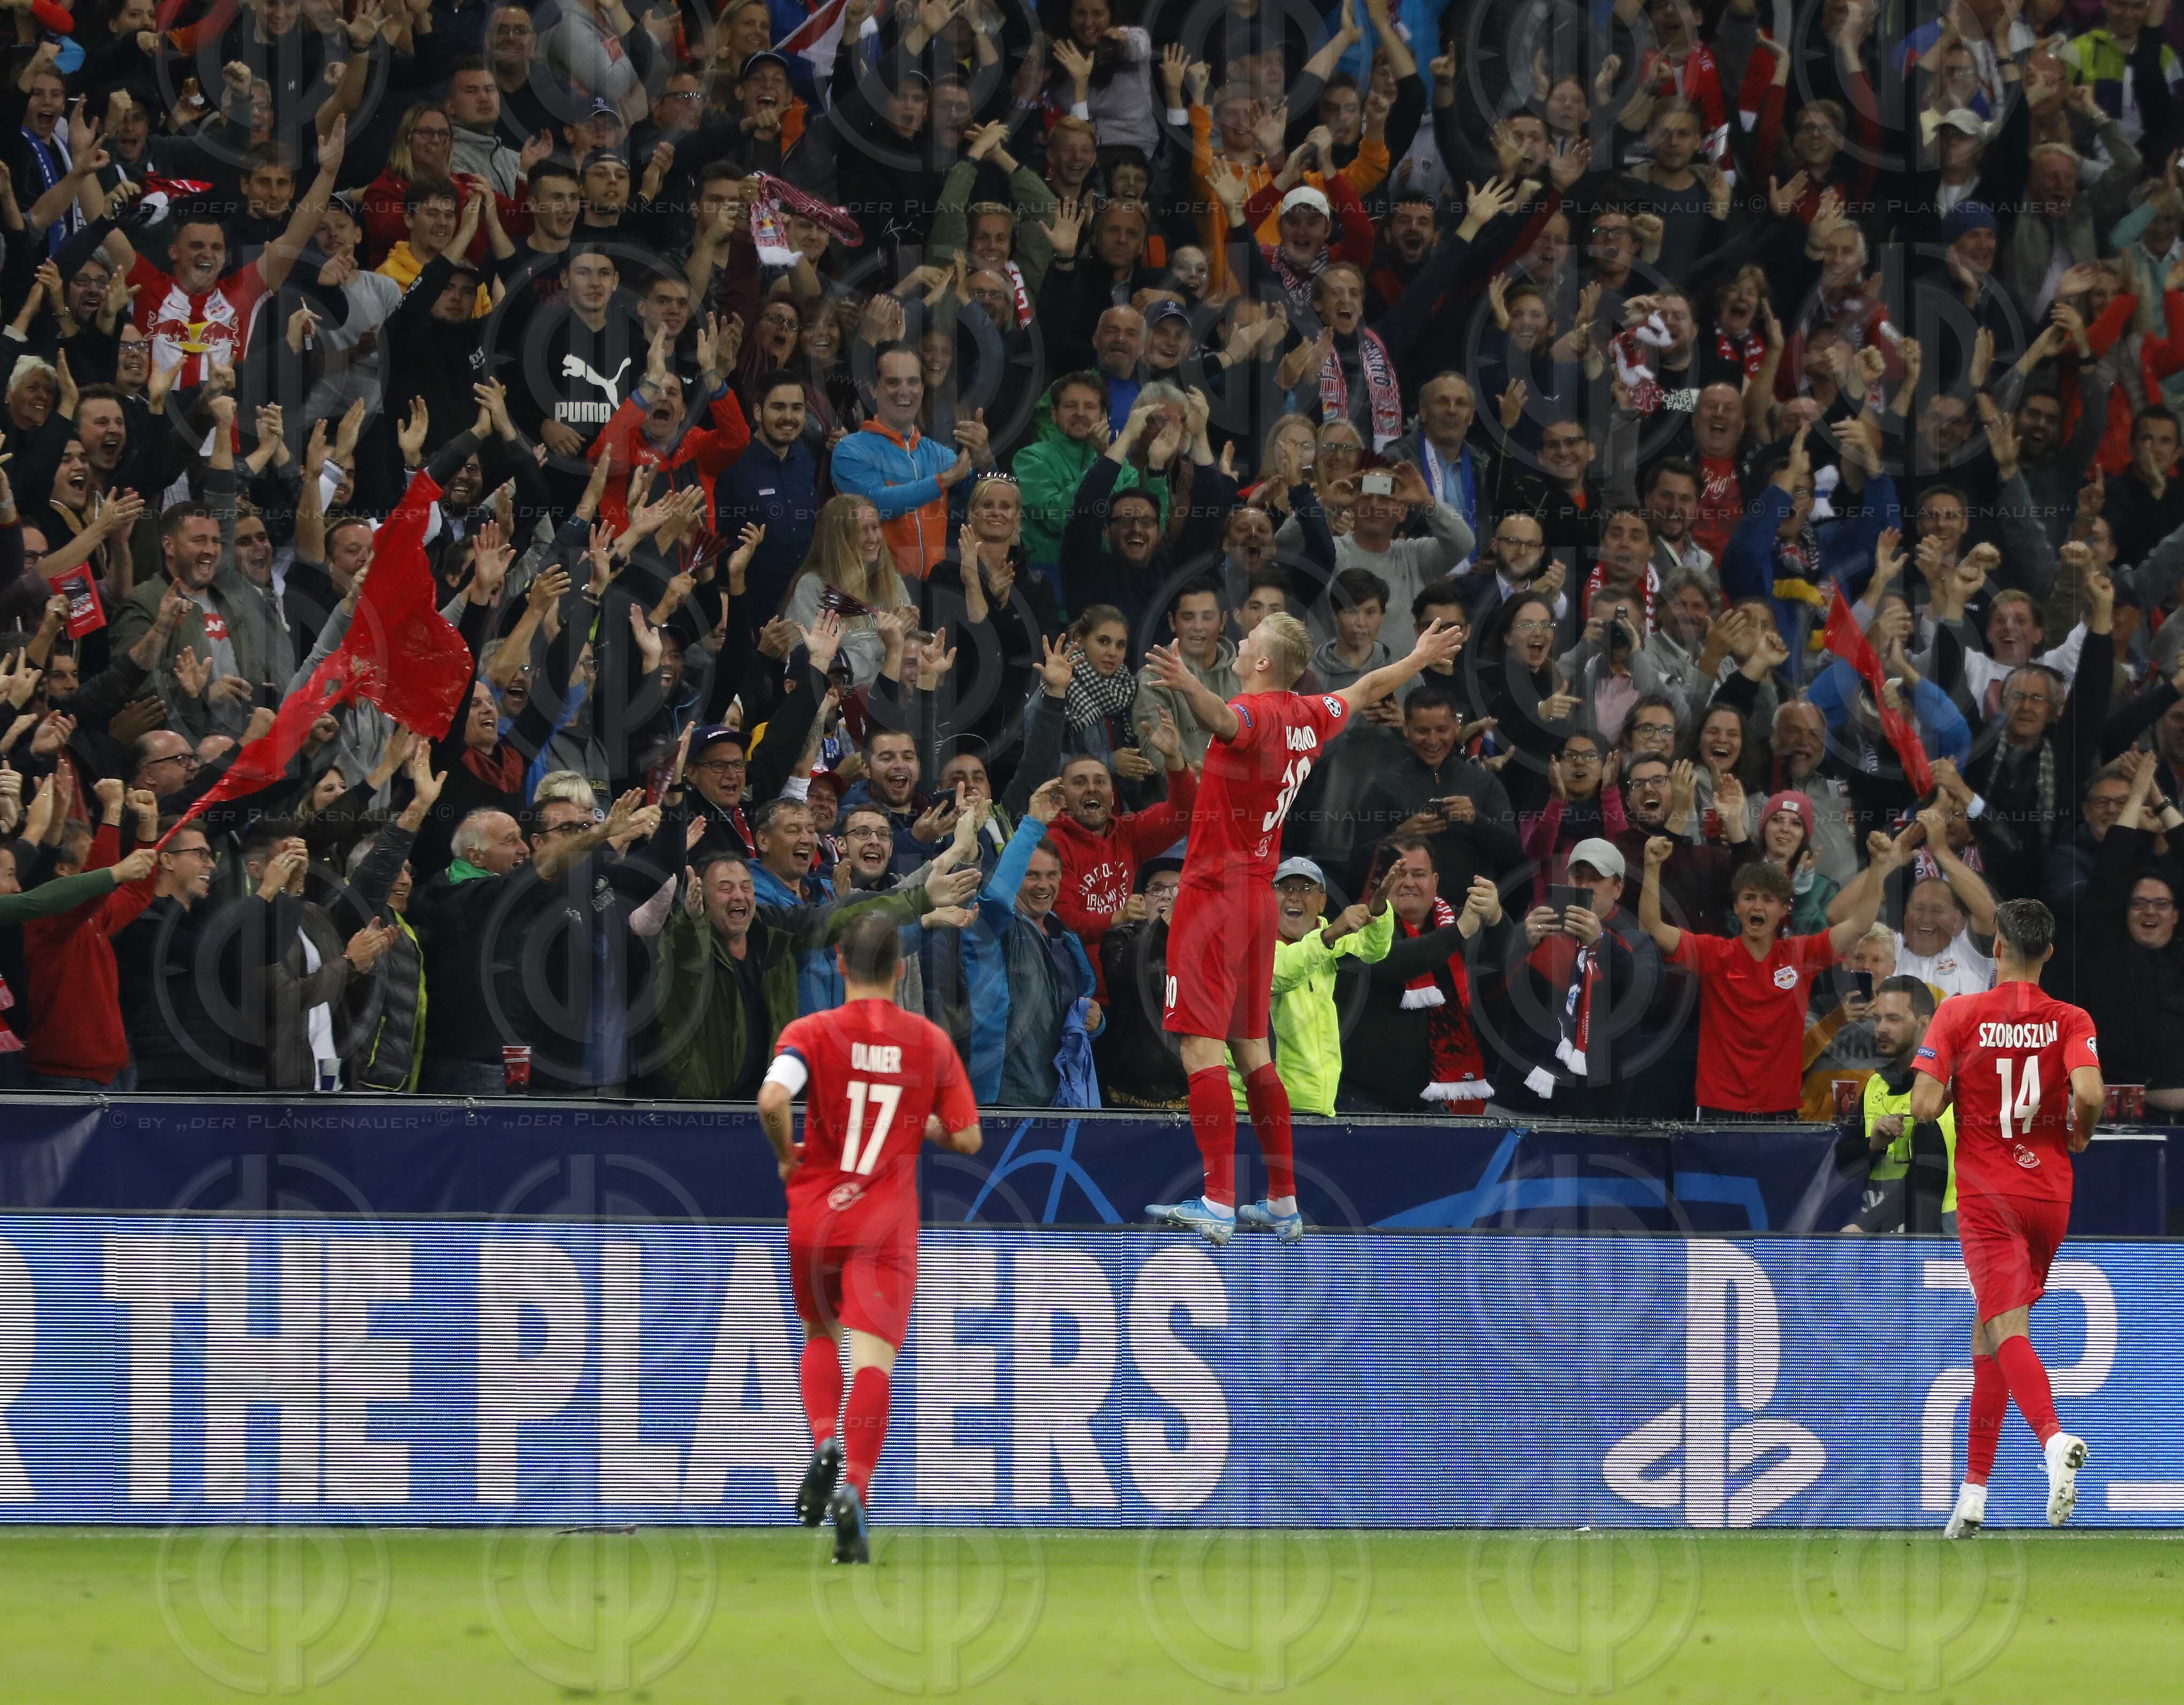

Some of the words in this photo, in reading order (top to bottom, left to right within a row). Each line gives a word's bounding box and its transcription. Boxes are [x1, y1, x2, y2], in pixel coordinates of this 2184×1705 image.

[555, 401, 611, 423] PUMA
[839, 1080, 904, 1176] 17
[1996, 1054, 2041, 1139] 14
[102, 1236, 412, 1505] THE
[476, 1238, 1231, 1511] PLAERS
